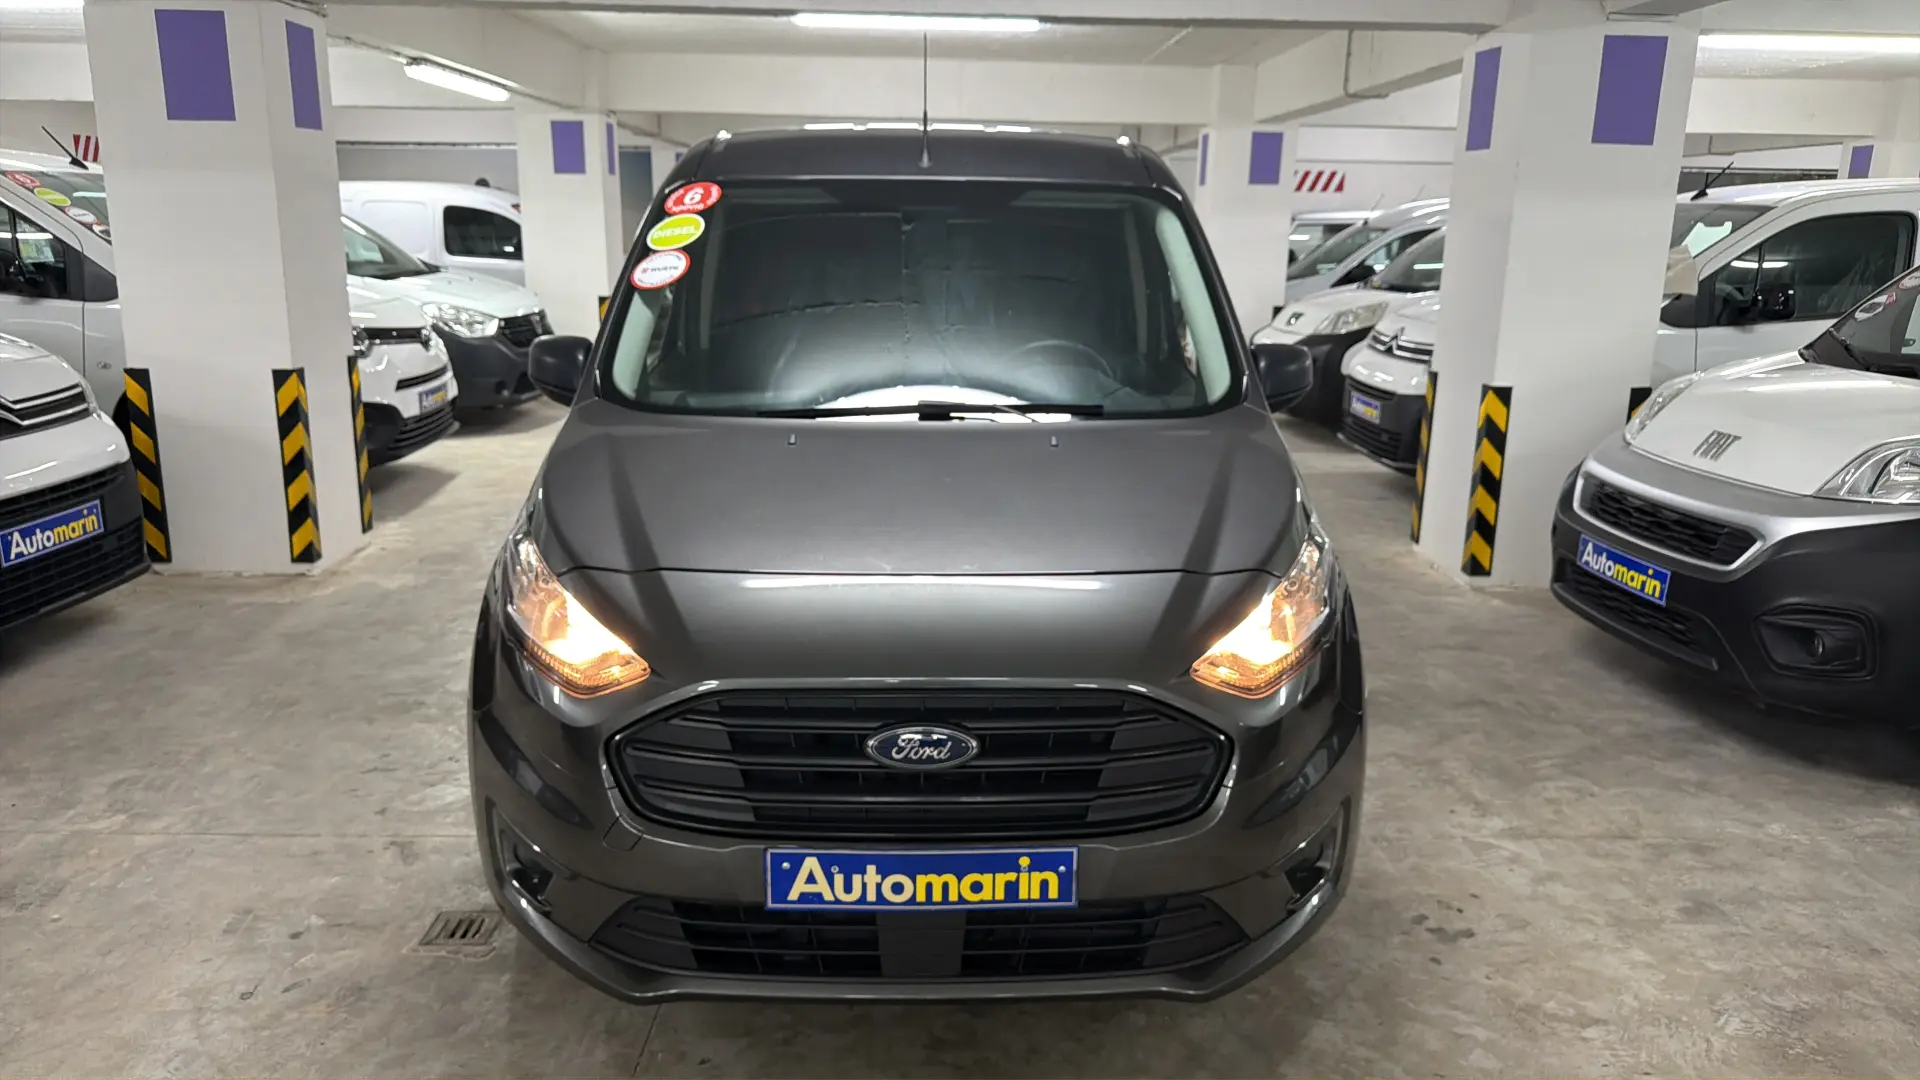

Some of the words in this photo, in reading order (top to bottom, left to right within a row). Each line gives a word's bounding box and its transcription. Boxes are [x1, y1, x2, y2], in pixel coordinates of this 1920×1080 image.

[683, 187, 704, 205] 6
[1693, 430, 1742, 461] FIAT
[10, 509, 98, 560] Automarin
[1581, 542, 1661, 598] Automarin
[891, 734, 952, 760] Ford
[787, 856, 1059, 903] Automarin
